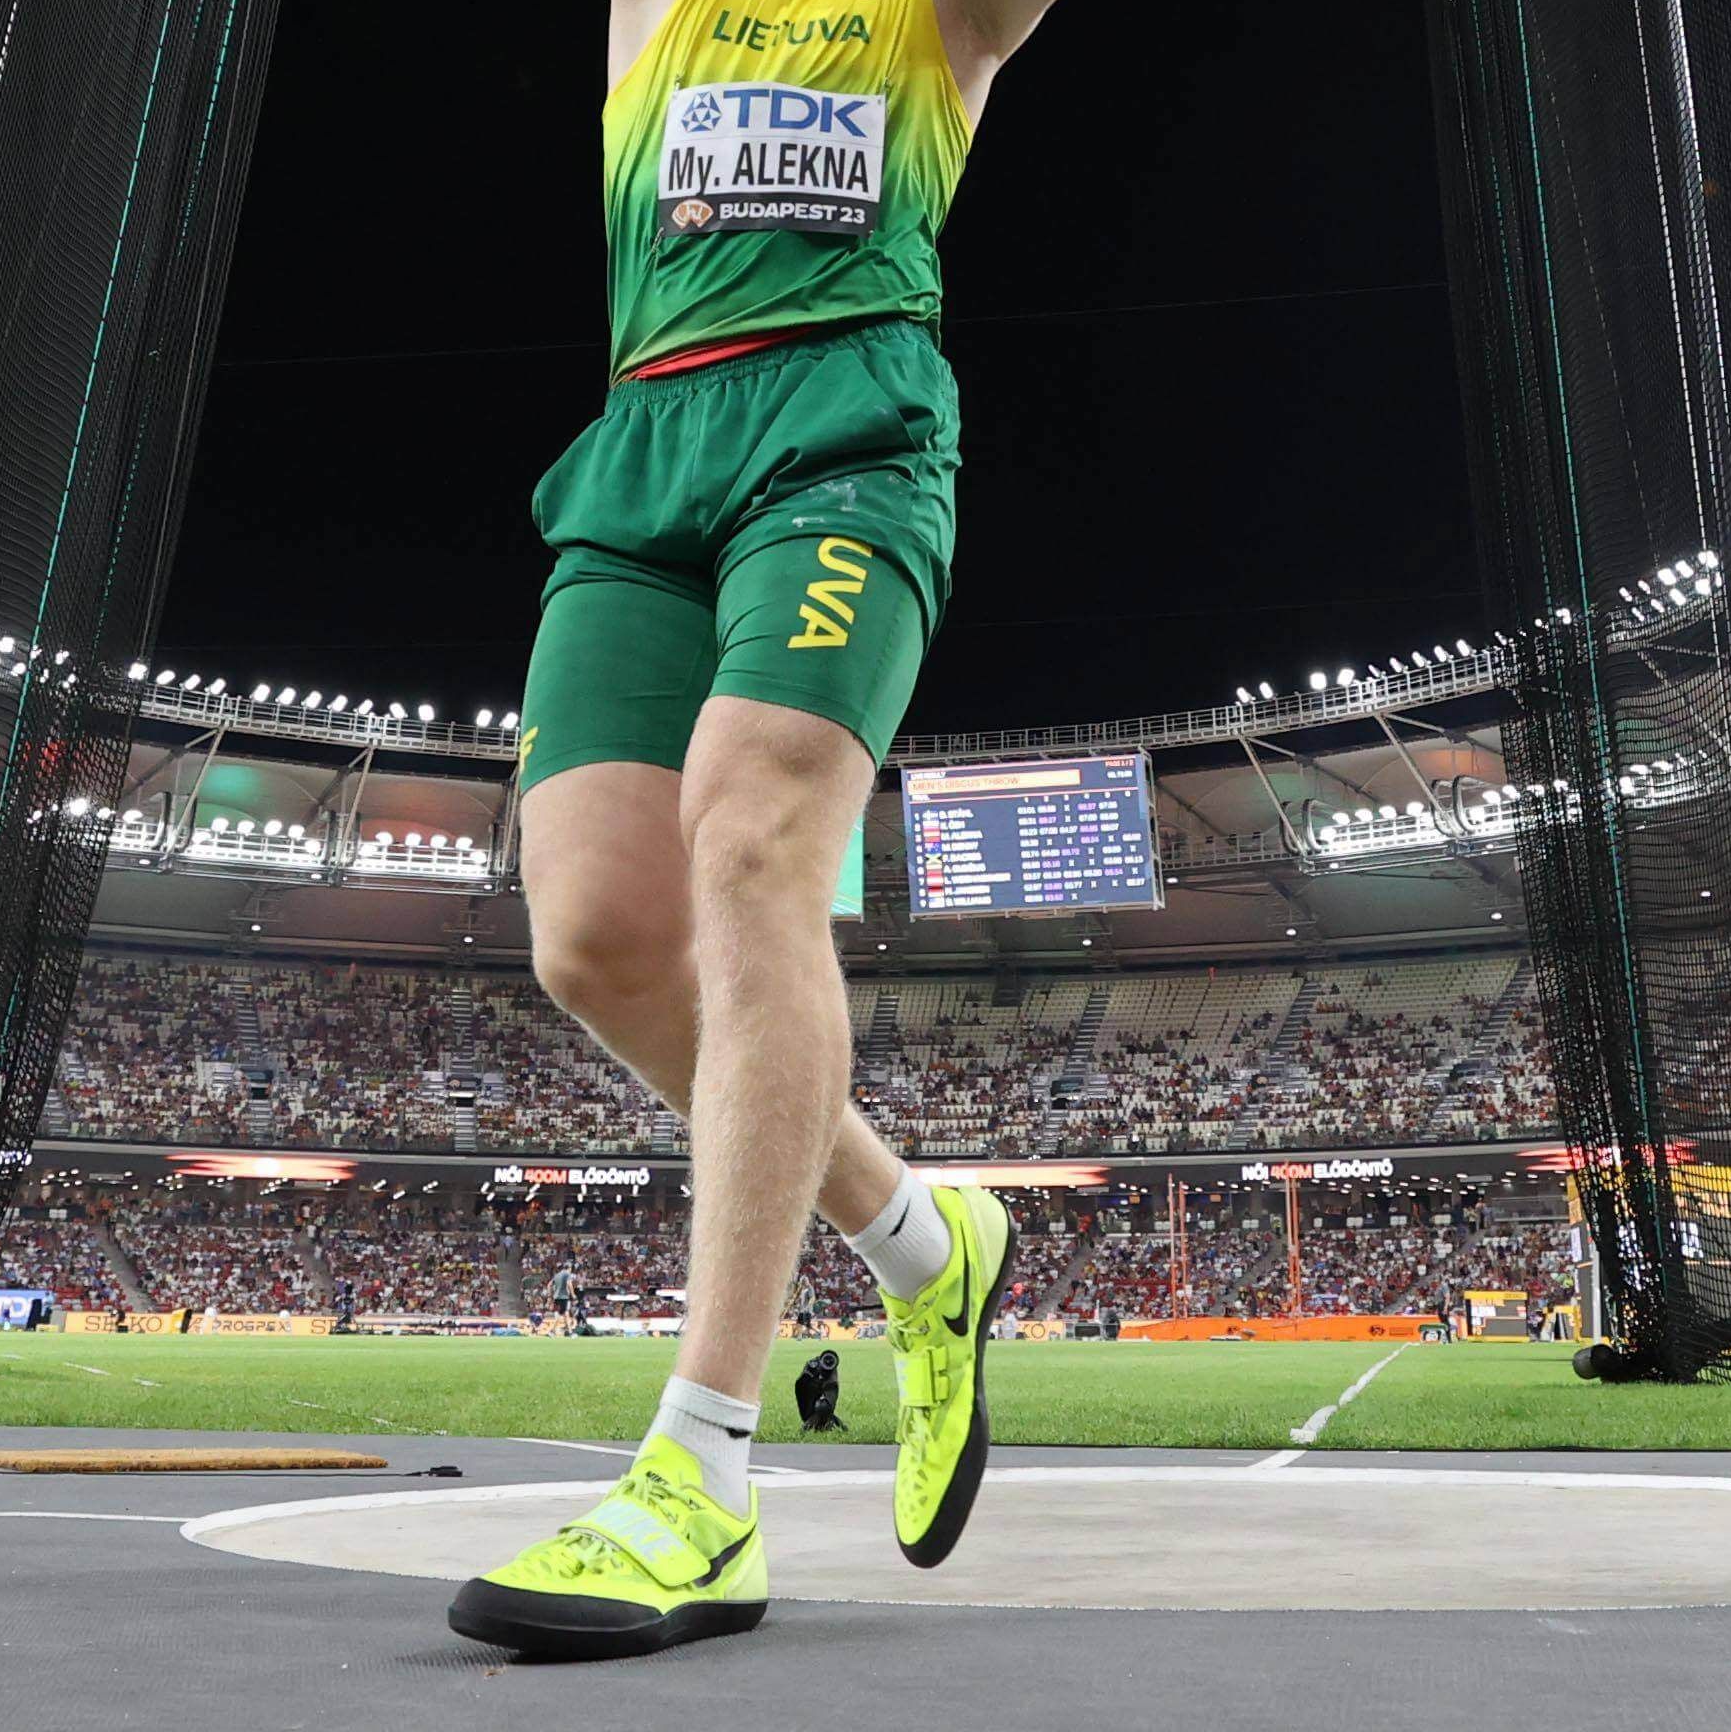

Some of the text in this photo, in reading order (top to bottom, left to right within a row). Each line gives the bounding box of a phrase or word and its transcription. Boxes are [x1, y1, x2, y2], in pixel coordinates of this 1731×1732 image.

[723, 88, 870, 138] TDK
[667, 142, 870, 196] My. ALEKNA
[719, 202, 866, 225] BUDAPEST 23
[494, 1164, 523, 1183] NŐI
[524, 1167, 567, 1184] 400M
[1241, 1162, 1268, 1181] NŐI
[84, 1315, 163, 1334] SEKO
